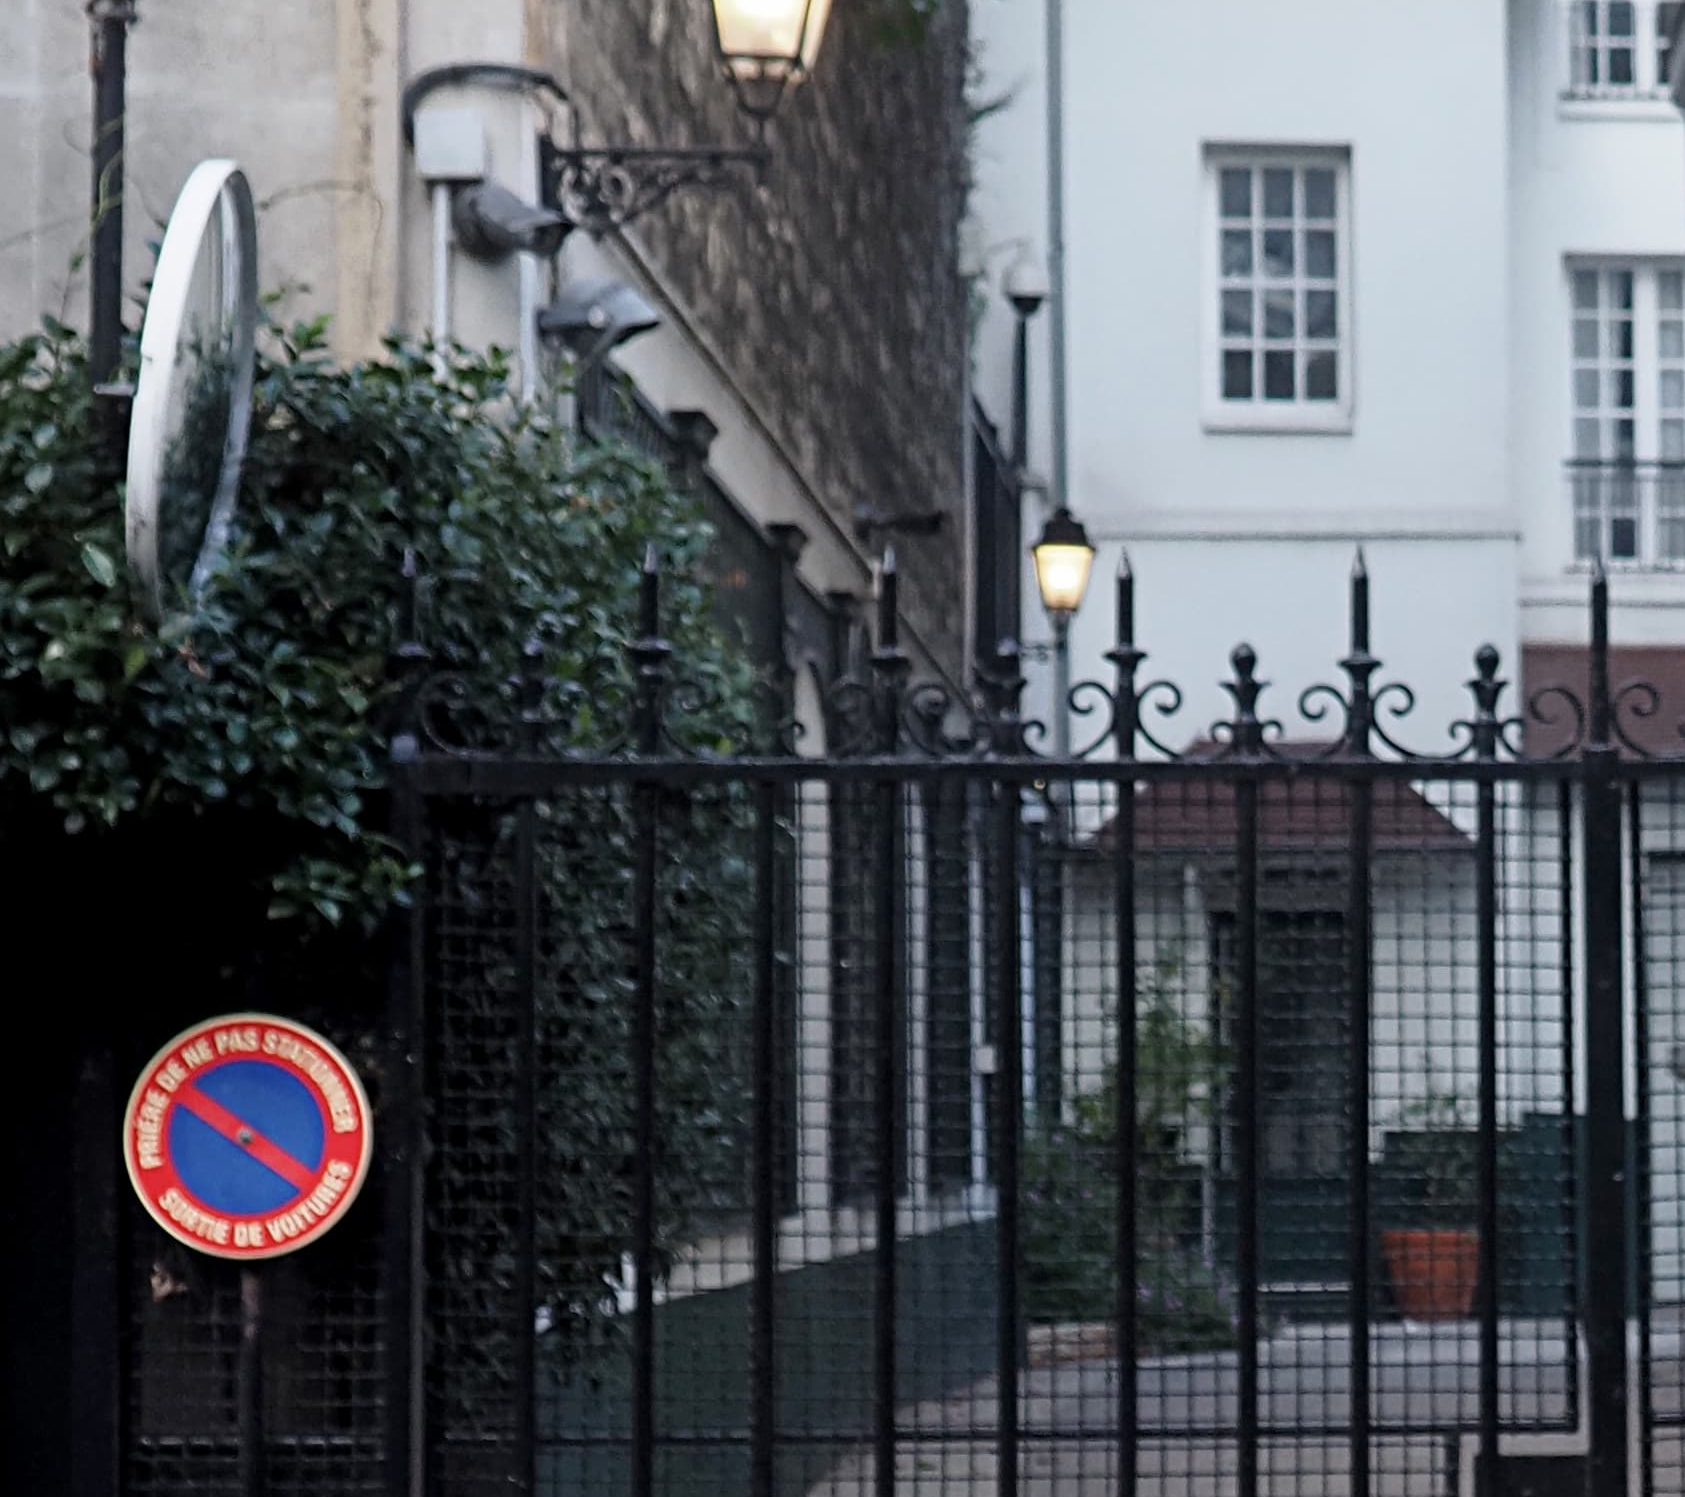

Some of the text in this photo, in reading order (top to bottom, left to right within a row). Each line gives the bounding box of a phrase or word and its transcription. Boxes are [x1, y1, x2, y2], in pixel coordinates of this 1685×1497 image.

[155, 1059, 186, 1093] DE
[181, 1039, 214, 1069] NE
[214, 1027, 258, 1055] PAS
[159, 1159, 353, 1247] SORTIE DE VOITURES
